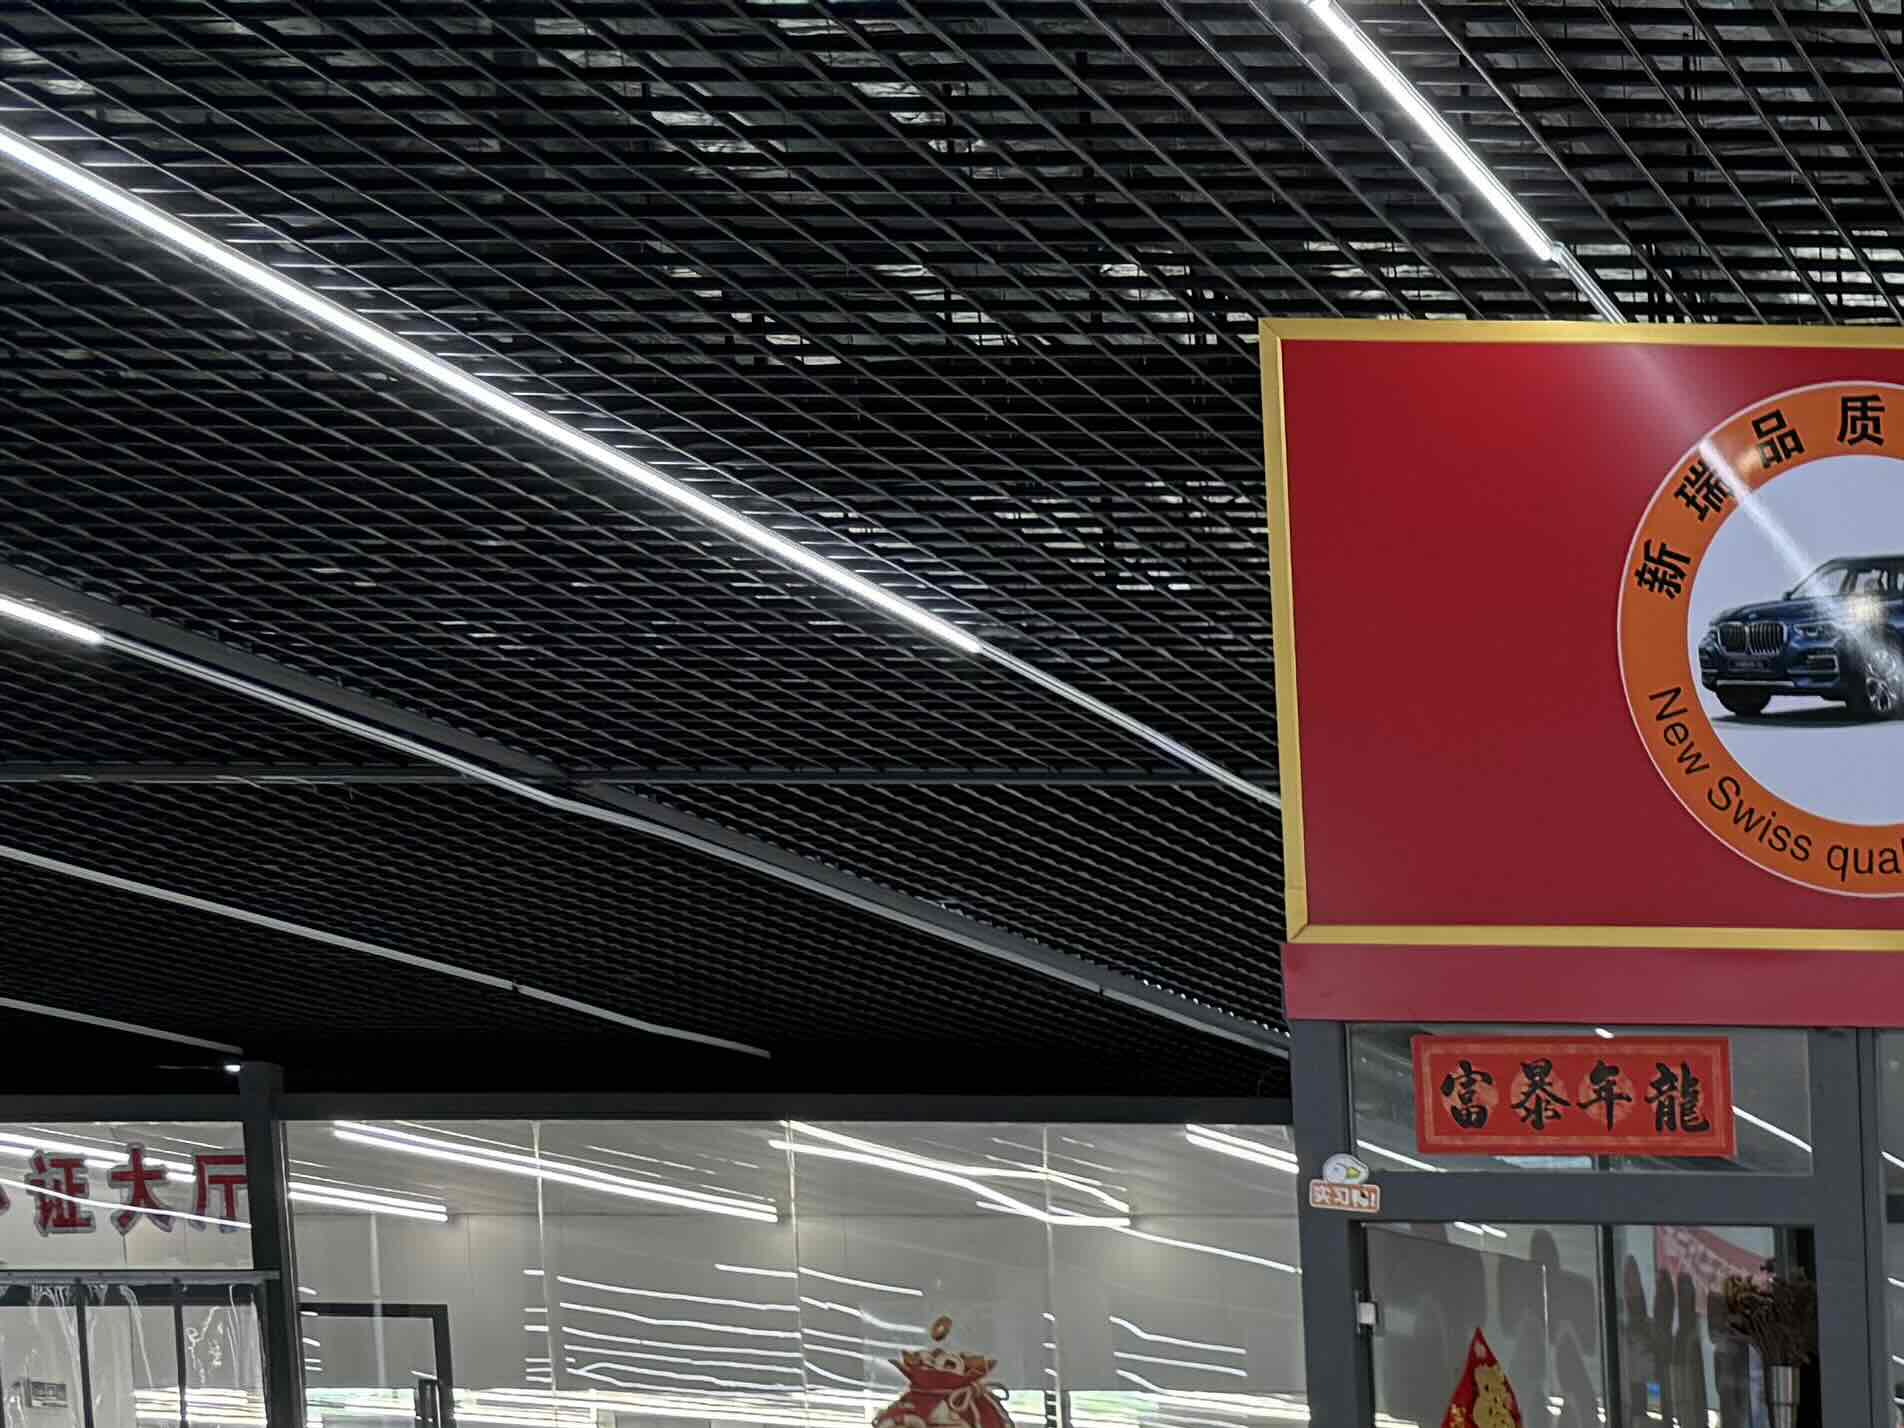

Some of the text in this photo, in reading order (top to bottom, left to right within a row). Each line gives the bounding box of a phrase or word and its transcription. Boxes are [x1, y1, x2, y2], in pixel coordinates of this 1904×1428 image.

[1649, 686, 1710, 776] New
[1707, 776, 1813, 862] Swiss
[0, 1143, 247, 1236] 证大厅
